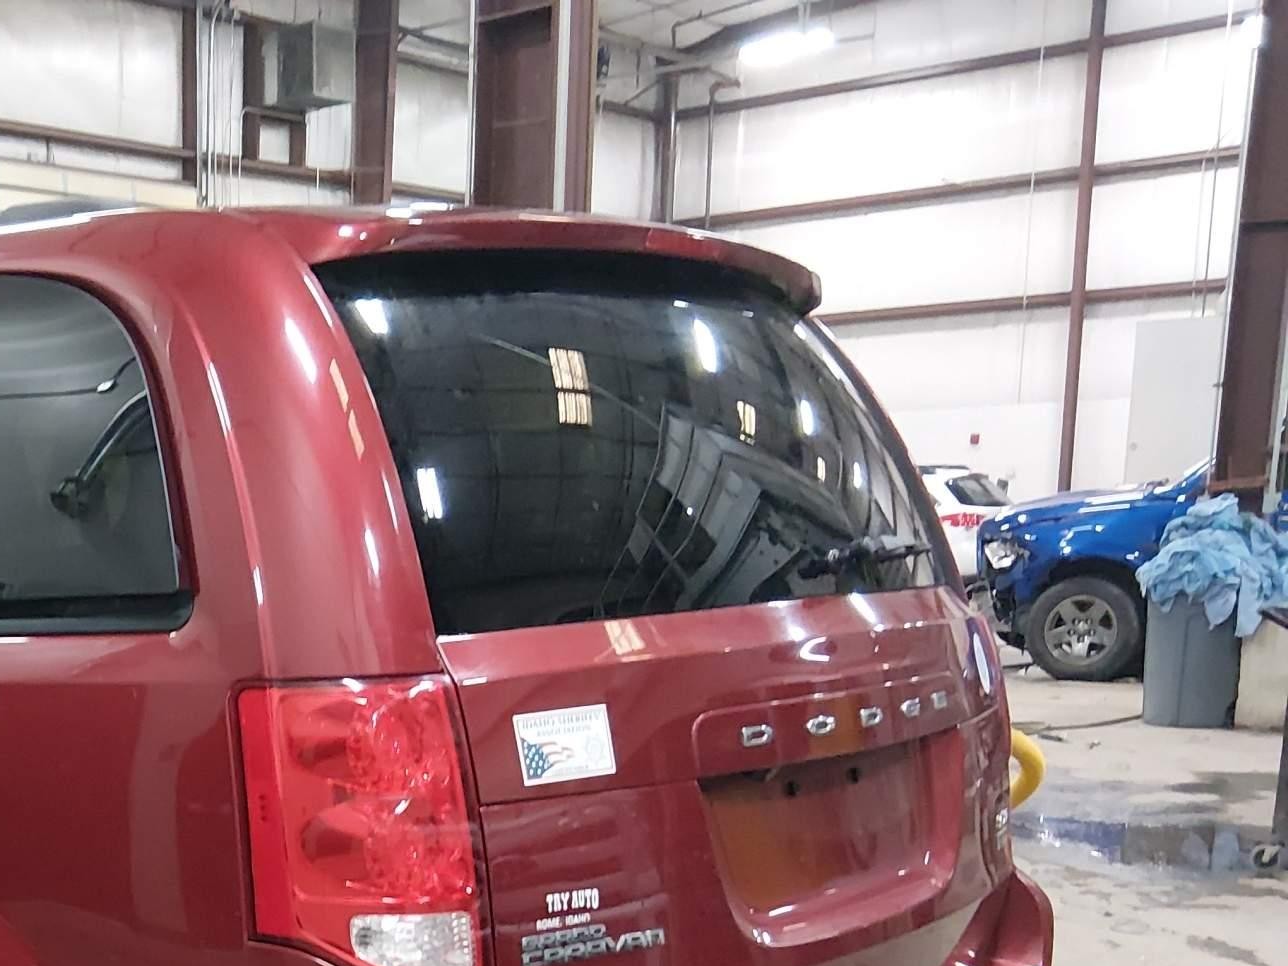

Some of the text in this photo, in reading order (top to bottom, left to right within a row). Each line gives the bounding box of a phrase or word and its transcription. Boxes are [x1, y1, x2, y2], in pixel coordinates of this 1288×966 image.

[741, 690, 949, 747] DODGE
[571, 887, 600, 910] AUTO
[521, 923, 607, 952] GRAND
